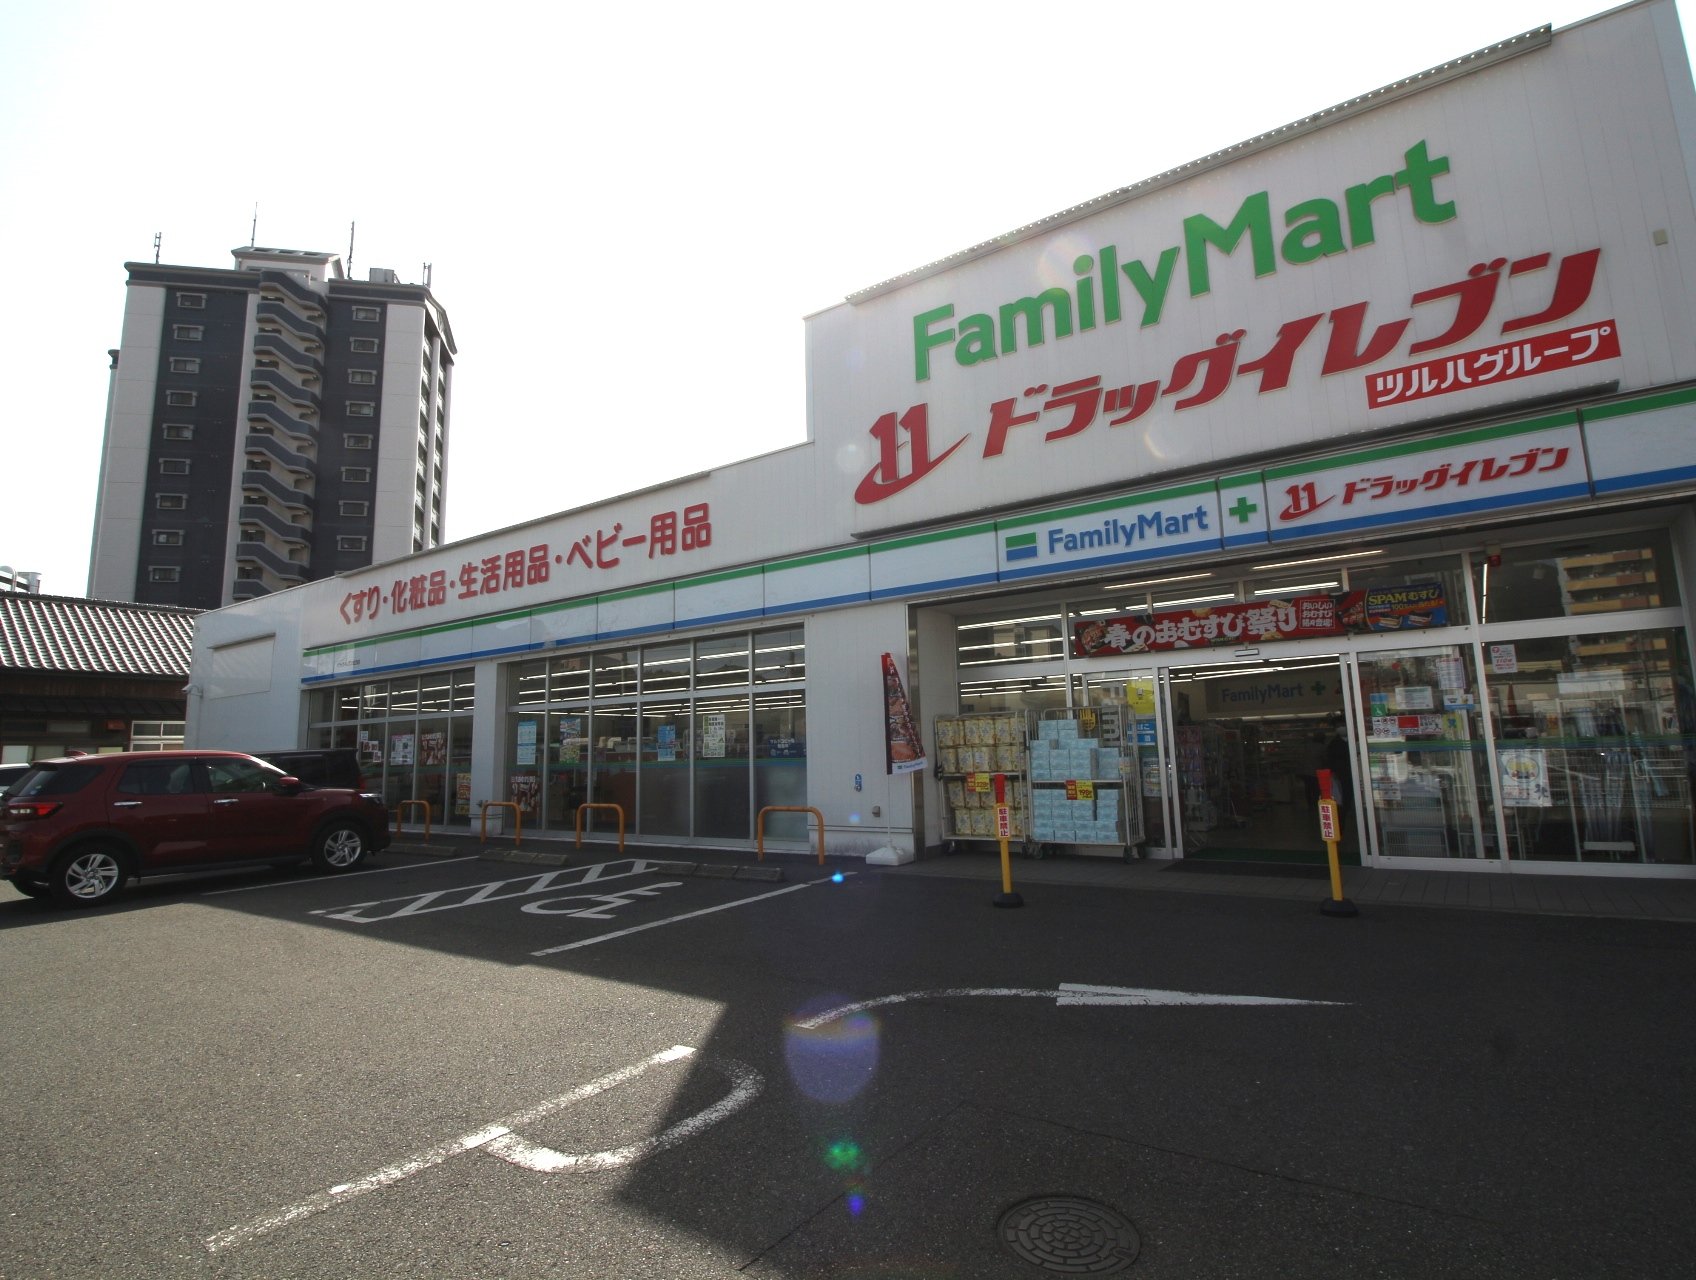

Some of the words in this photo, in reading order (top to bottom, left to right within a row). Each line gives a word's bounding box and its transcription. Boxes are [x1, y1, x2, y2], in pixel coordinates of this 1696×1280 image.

[914, 140, 1457, 382] FamilyMart
[983, 248, 1600, 458] ドラッグイレブン
[1376, 326, 1611, 403] ツルハグループ
[1341, 446, 1570, 506] ドラッグイレブン
[1048, 505, 1209, 554] FamilyMart
[1302, 609, 1333, 618] おむすび
[1368, 588, 1440, 606] SPAMむすび
[1104, 607, 1298, 648] 春のおむすび祭り
[1221, 682, 1304, 704] FamilyMart
[998, 807, 1009, 837] 駐車禁止
[1320, 805, 1333, 838] 駐車禁止
